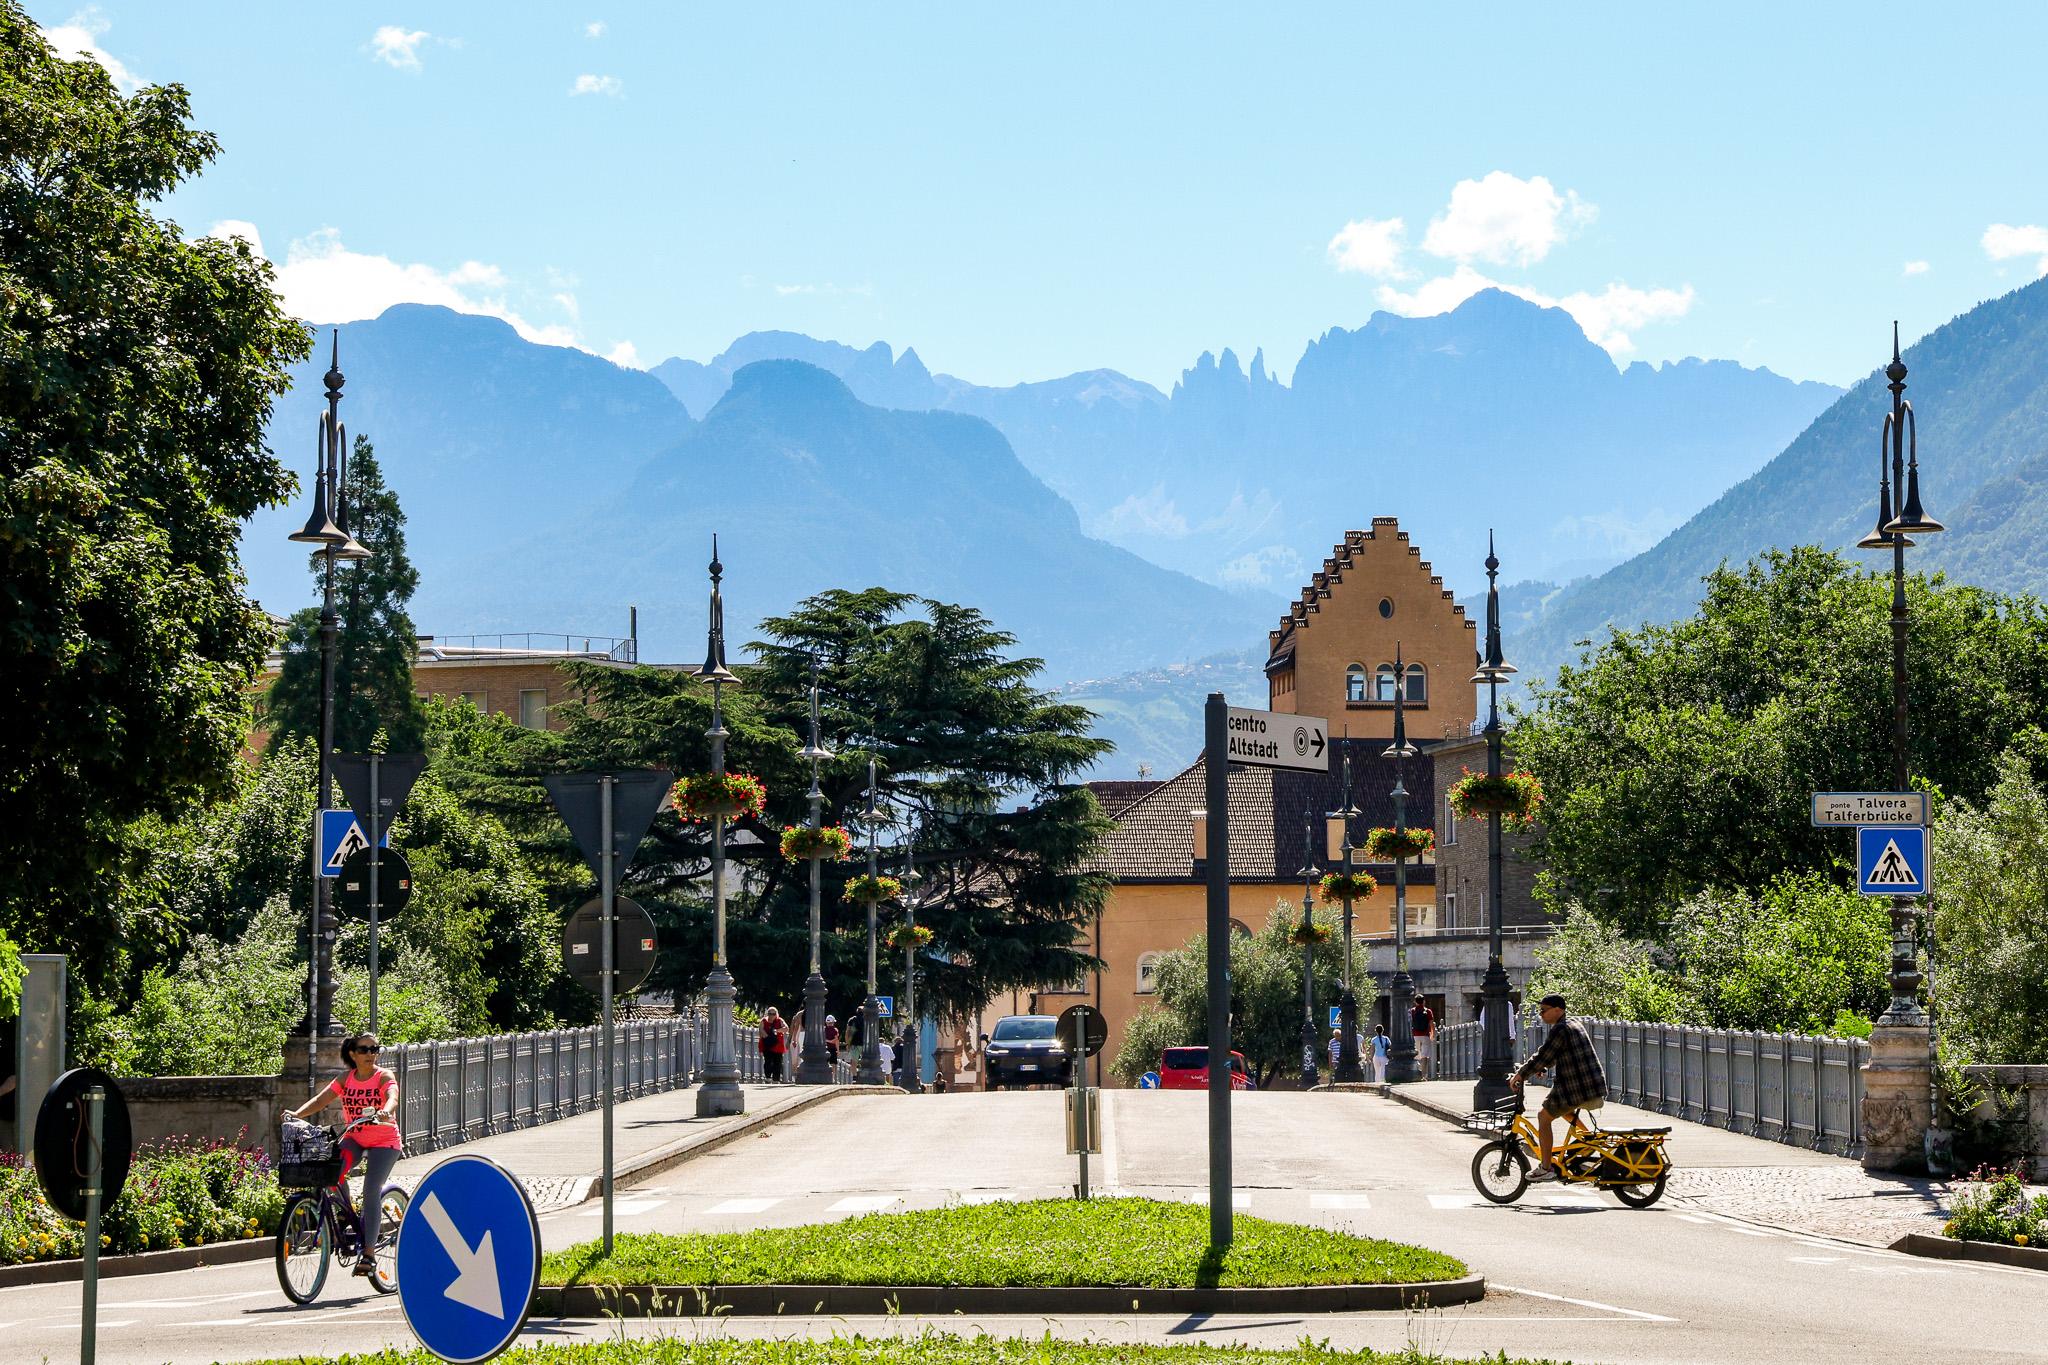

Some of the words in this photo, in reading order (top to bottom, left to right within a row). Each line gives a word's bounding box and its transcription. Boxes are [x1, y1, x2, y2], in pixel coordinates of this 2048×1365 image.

[1229, 715, 1267, 733] centro
[1229, 736, 1279, 759] Altstadt
[1857, 798, 1907, 809] Talvera
[1825, 810, 1913, 821] Talferbrücke
[343, 1087, 381, 1097] SUPER
